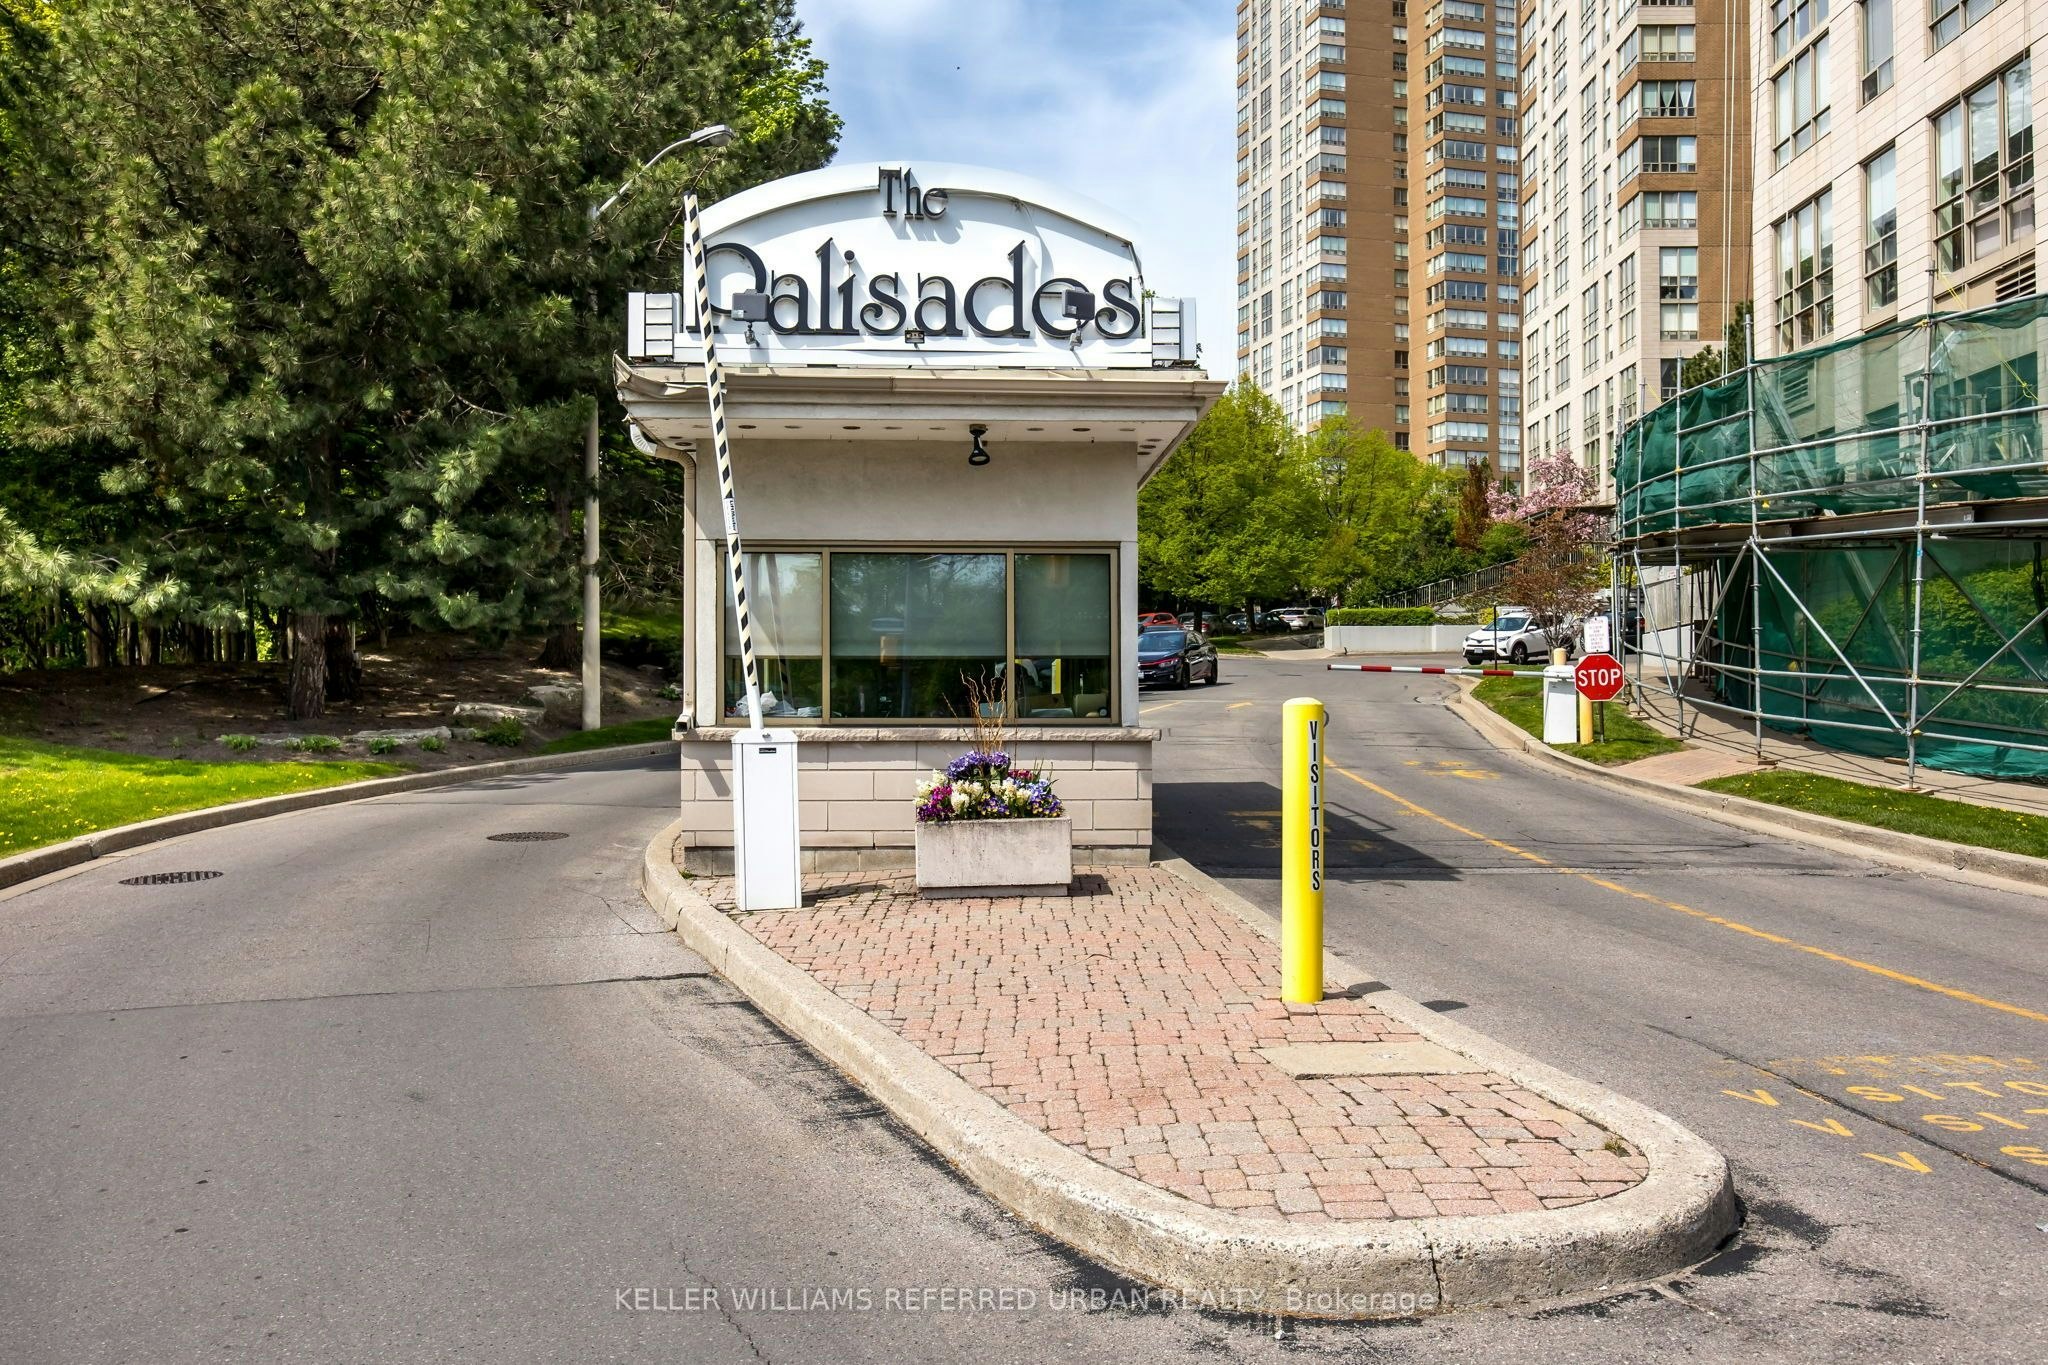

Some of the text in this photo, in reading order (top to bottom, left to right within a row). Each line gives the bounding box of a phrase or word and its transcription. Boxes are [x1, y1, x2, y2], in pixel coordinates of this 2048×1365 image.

[878, 166, 948, 220] The
[686, 237, 1141, 339] Palisades
[1577, 668, 1620, 687] STOP
[1309, 720, 1321, 891] VISITORS
